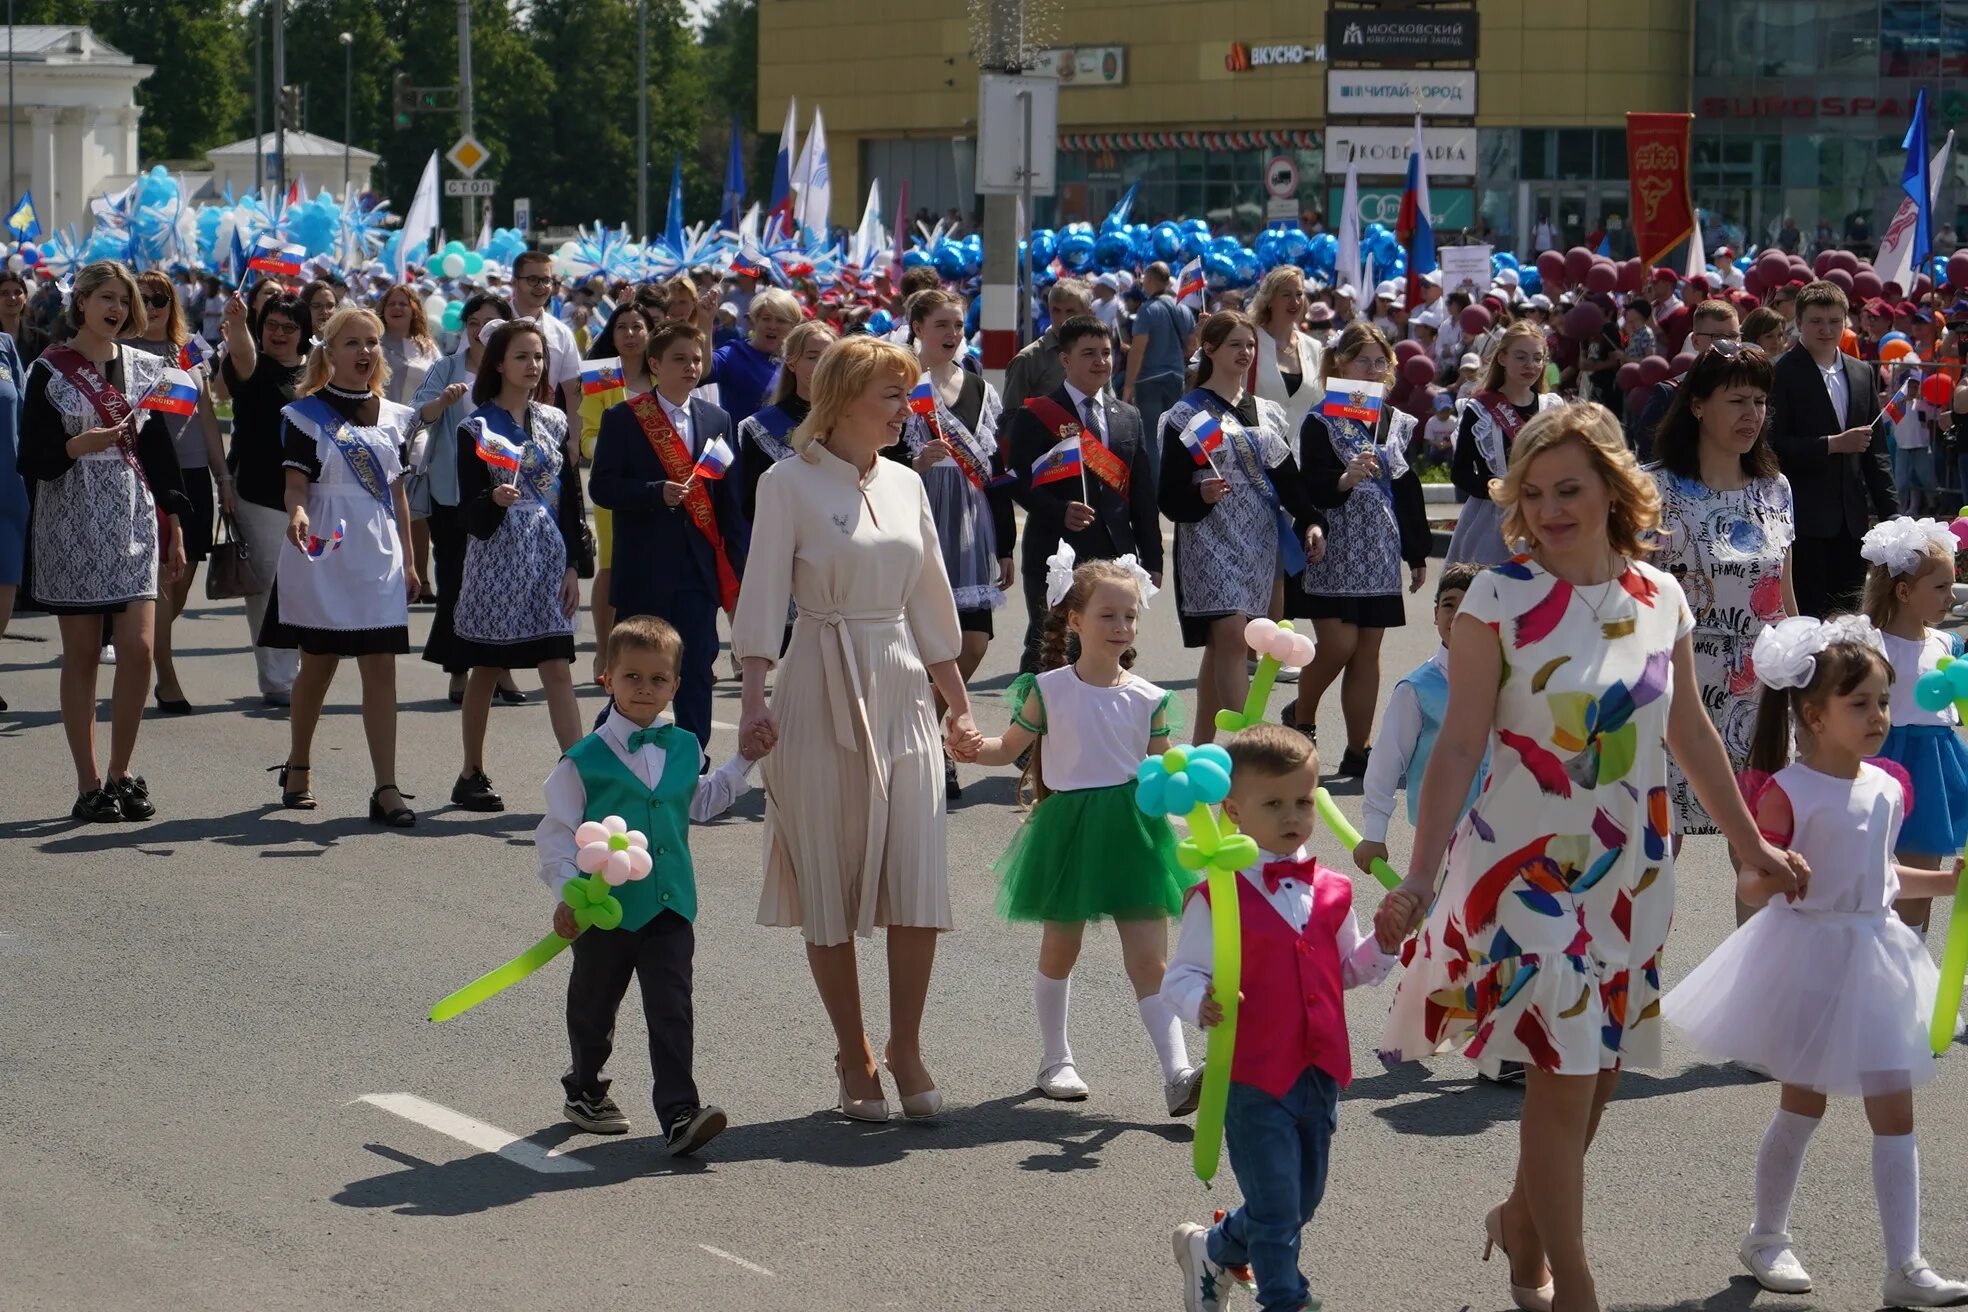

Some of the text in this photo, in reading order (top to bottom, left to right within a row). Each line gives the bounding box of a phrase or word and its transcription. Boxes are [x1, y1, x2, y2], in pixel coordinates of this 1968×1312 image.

[1366, 23, 1463, 34] МОСКОВСКИЙ
[1366, 35, 1462, 45] ЮВЕЛИРНЫЙ ЗАВОД
[1364, 83, 1462, 100] ЧИТАЙ-ОРОД
[1360, 144, 1466, 161] КОФЕАРКА
[449, 182, 490, 193] СТОП
